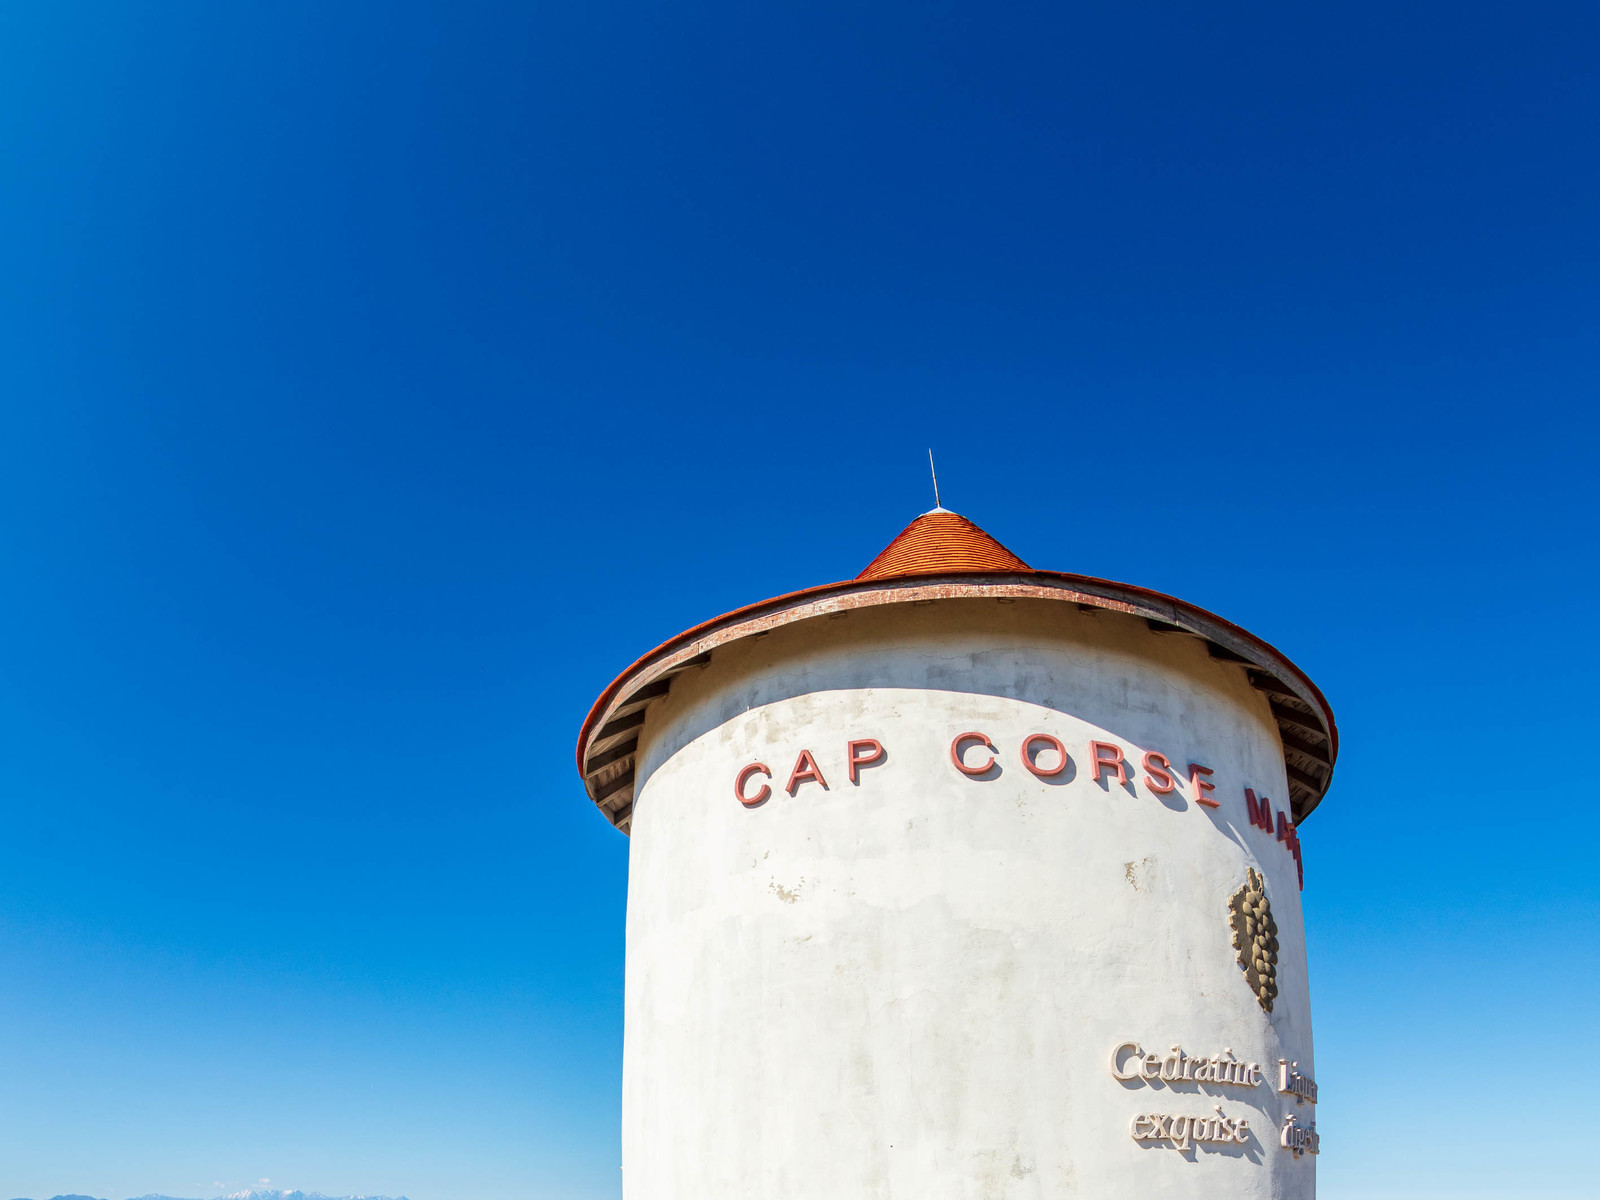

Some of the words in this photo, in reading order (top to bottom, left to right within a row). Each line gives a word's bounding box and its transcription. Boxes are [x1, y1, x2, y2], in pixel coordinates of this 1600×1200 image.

[734, 738, 883, 805] CAP
[950, 731, 1221, 808] CORSE
[1110, 1041, 1263, 1087] Cedratine
[1129, 1105, 1250, 1151] exquise
